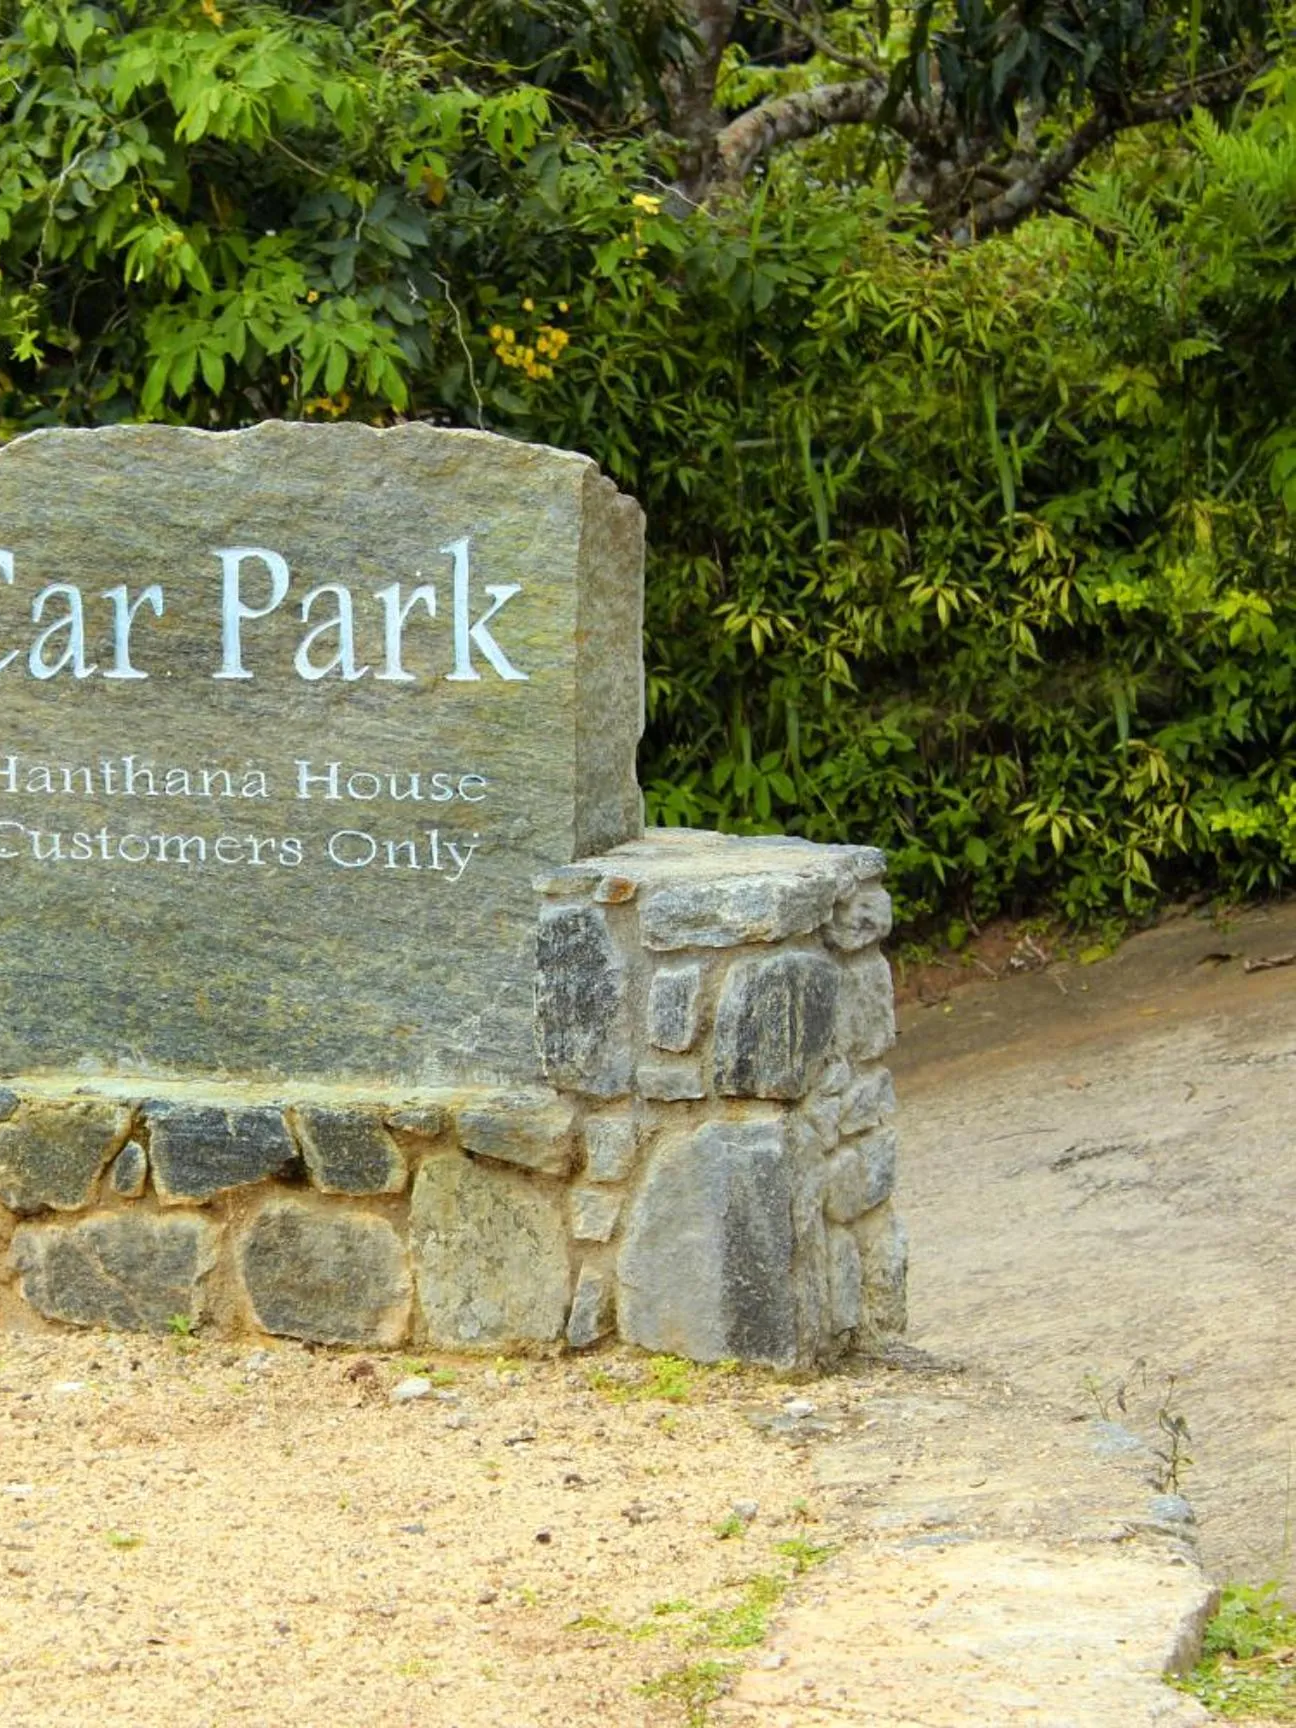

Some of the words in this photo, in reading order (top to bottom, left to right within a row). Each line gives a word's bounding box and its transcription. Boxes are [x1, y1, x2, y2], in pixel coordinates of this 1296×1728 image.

[211, 535, 531, 684] Park
[294, 759, 491, 804] House
[325, 828, 480, 883] Only
